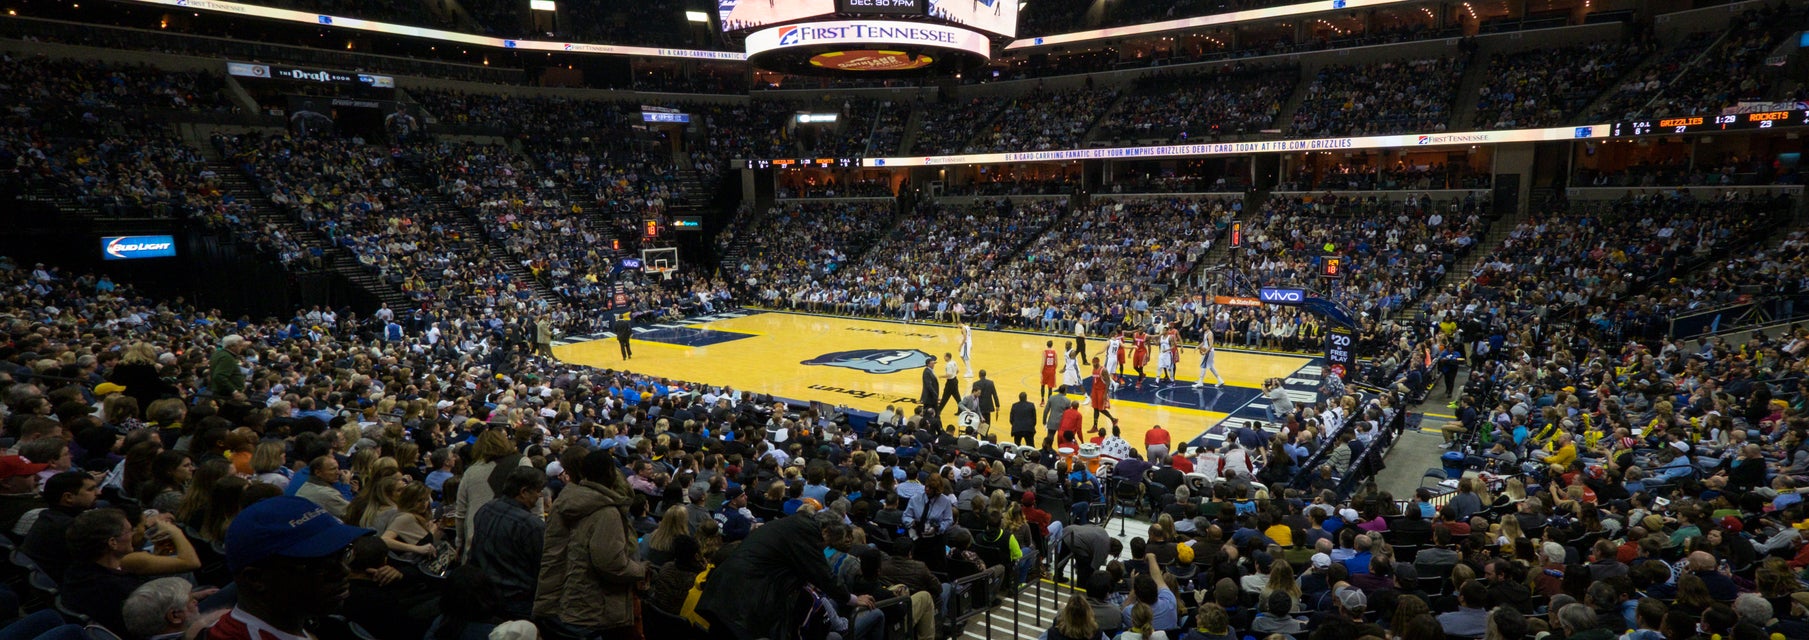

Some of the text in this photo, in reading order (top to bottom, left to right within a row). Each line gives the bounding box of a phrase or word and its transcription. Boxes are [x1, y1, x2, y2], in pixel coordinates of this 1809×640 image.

[801, 24, 956, 44] FIRST TENNESSEE
[292, 70, 330, 82] Draft
[1660, 118, 1703, 127] GRIZZLIES
[1715, 116, 1736, 124] 1:29
[1750, 112, 1788, 122] ROCKETS
[1157, 146, 1190, 154] GRIZZLIES
[1192, 145, 1212, 154] DEBIT
[1215, 144, 1232, 152] CARD
[1236, 143, 1258, 151] TODAY
[1273, 139, 1352, 150] FTB.COM/GRIZZLIES
[1264, 290, 1299, 300] vivo
[1331, 334, 1350, 346] $20
